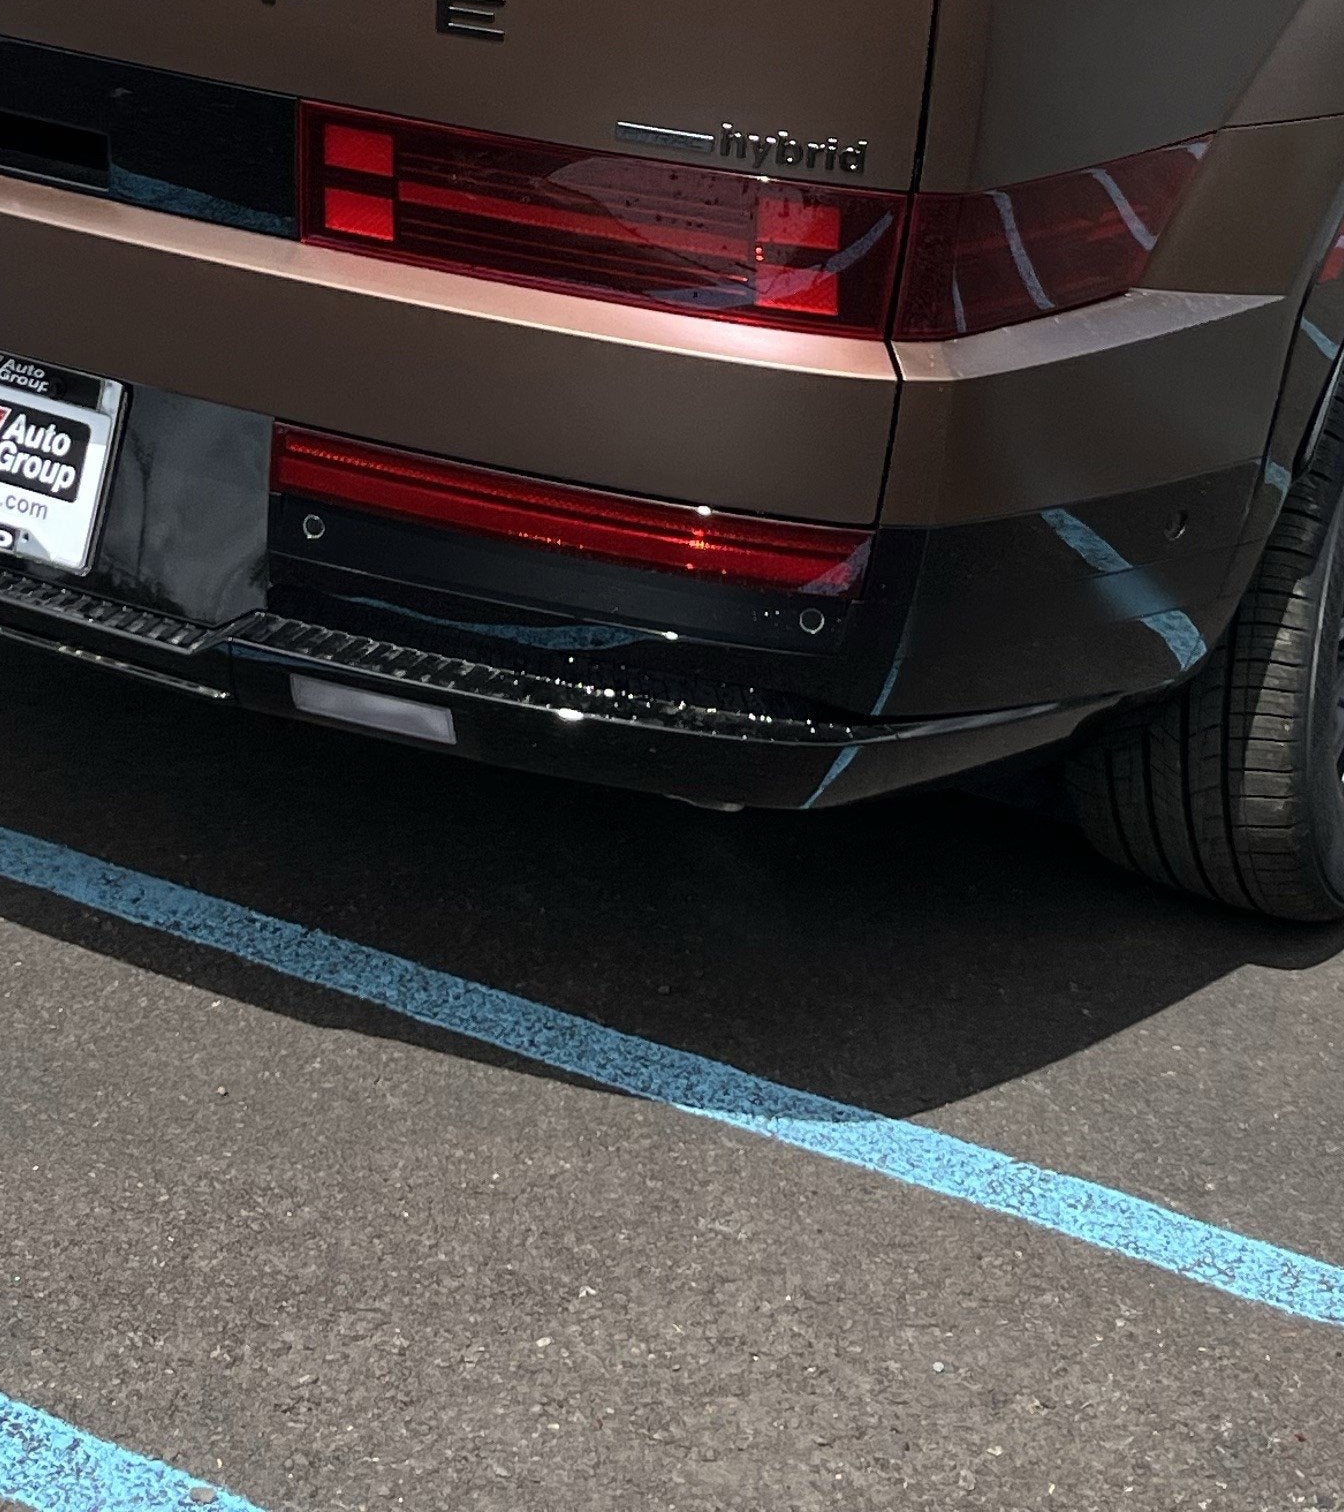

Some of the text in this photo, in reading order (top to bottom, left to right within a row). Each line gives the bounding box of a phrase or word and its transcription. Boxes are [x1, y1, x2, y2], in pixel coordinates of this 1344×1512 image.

[718, 121, 868, 174] hybrid
[5, 358, 46, 379] Auto
[2, 414, 72, 457] Auto
